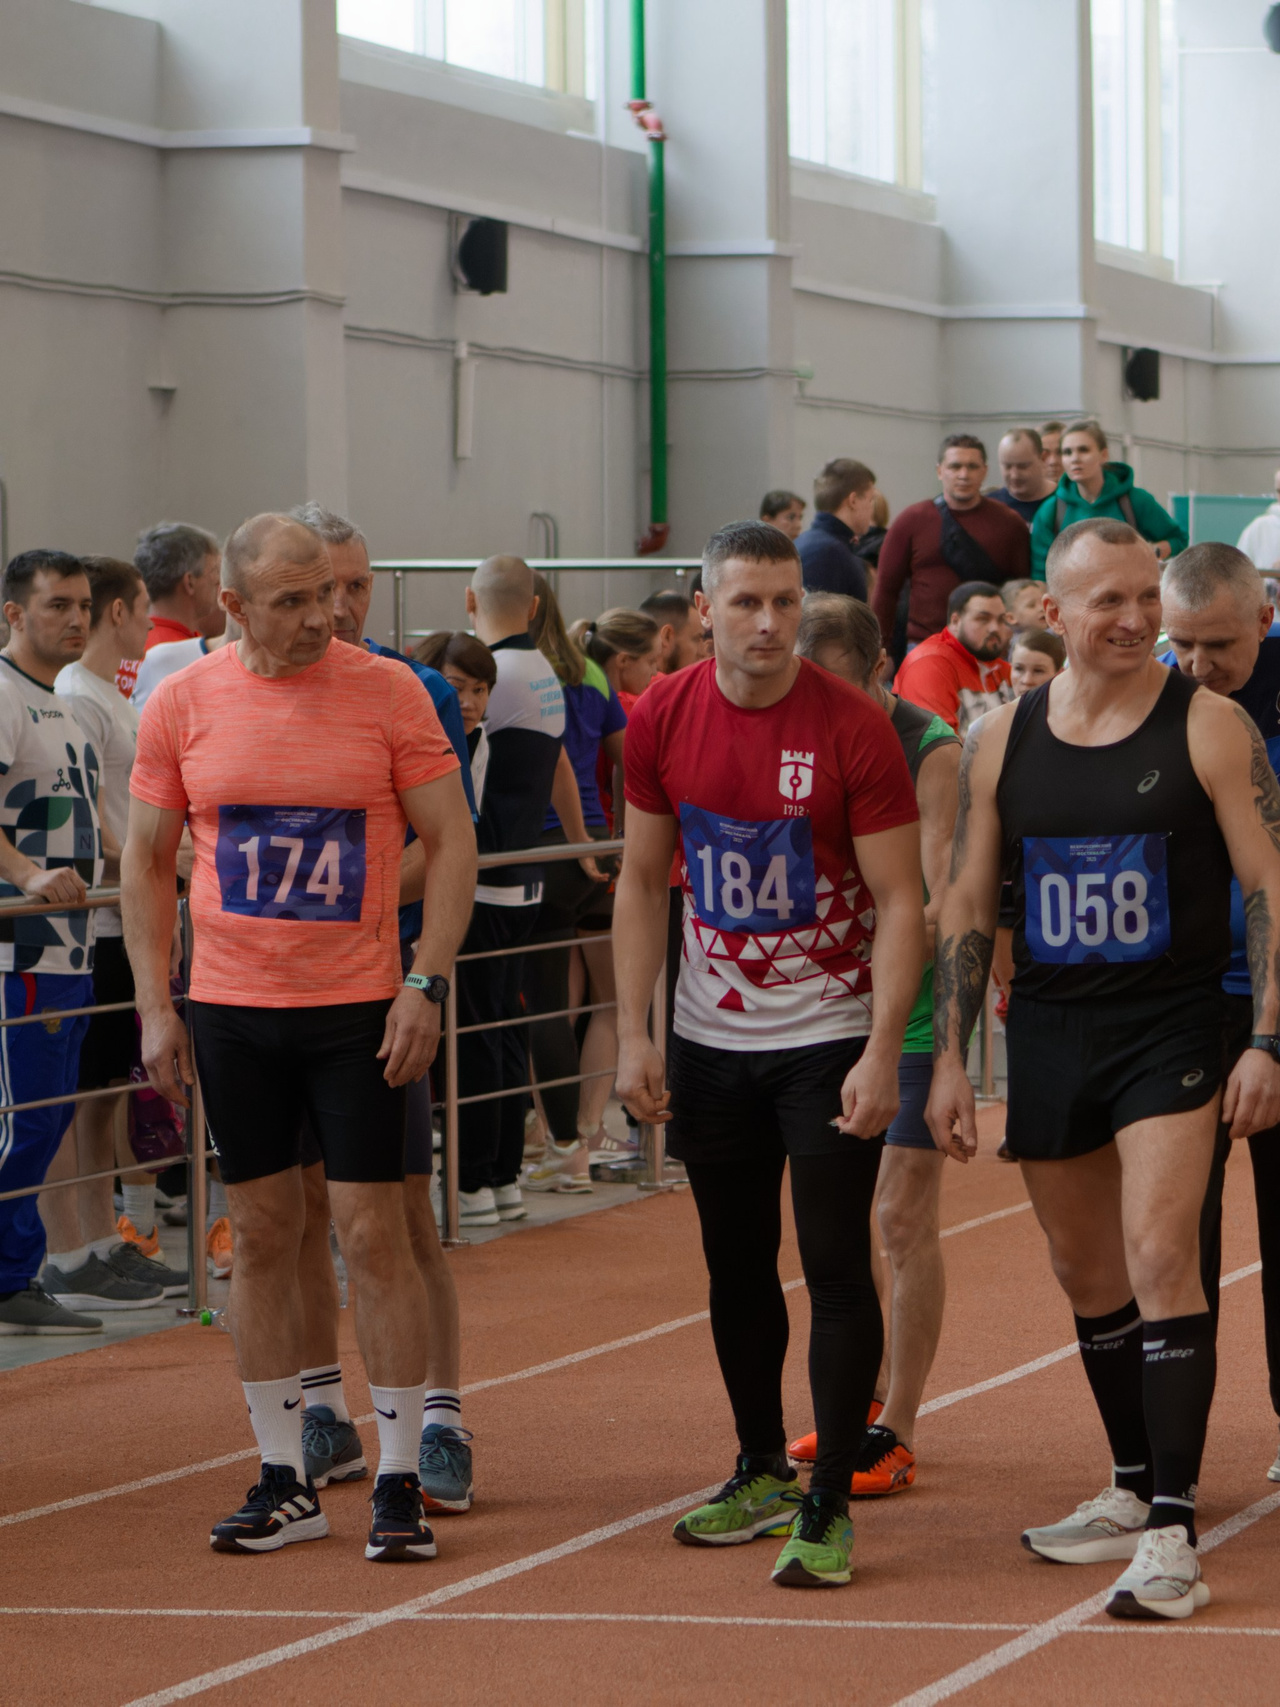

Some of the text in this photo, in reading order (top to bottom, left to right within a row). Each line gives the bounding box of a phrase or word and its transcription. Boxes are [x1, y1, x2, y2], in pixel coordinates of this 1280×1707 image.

[784, 803, 805, 816] 1712
[238, 835, 344, 906] 174
[697, 844, 794, 920] 184
[1040, 870, 1149, 947] 058
